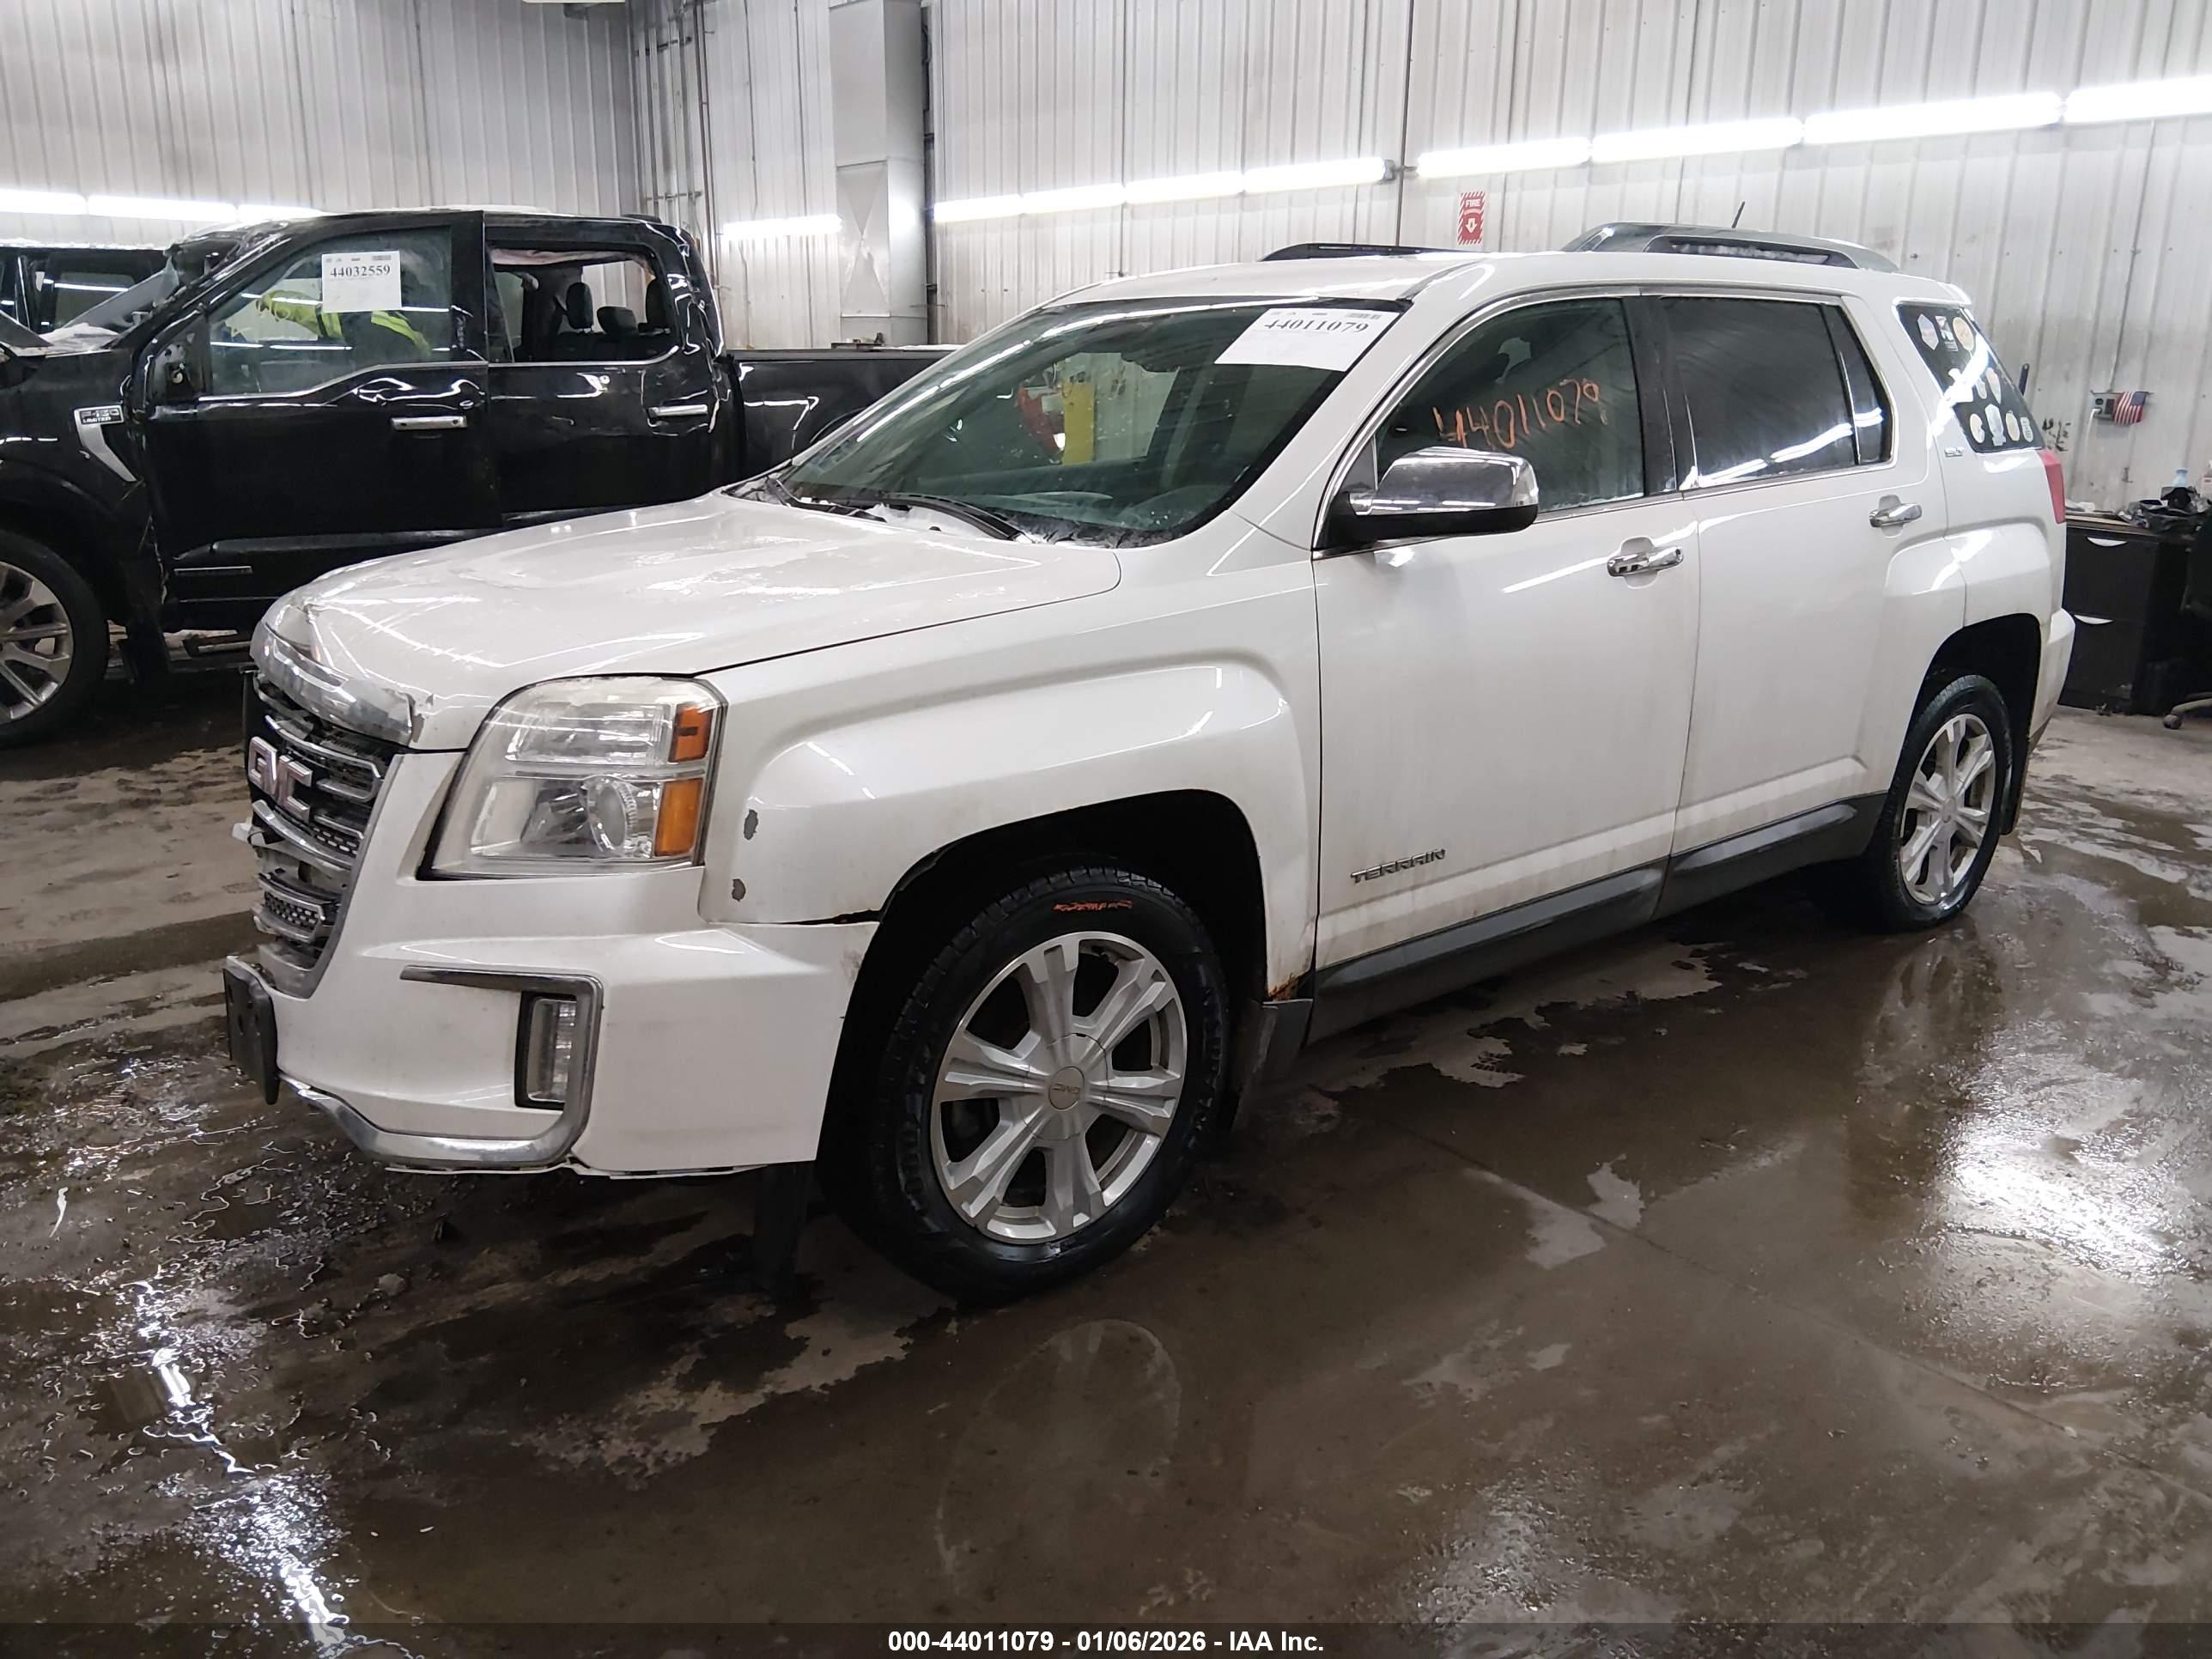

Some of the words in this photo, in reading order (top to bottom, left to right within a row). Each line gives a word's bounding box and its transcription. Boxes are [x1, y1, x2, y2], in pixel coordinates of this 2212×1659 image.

[330, 264, 391, 277] 44032559
[1264, 319, 1370, 333] 44011079
[1431, 378, 1608, 451] 44011079
[1350, 848, 1446, 884] TERRAIN
